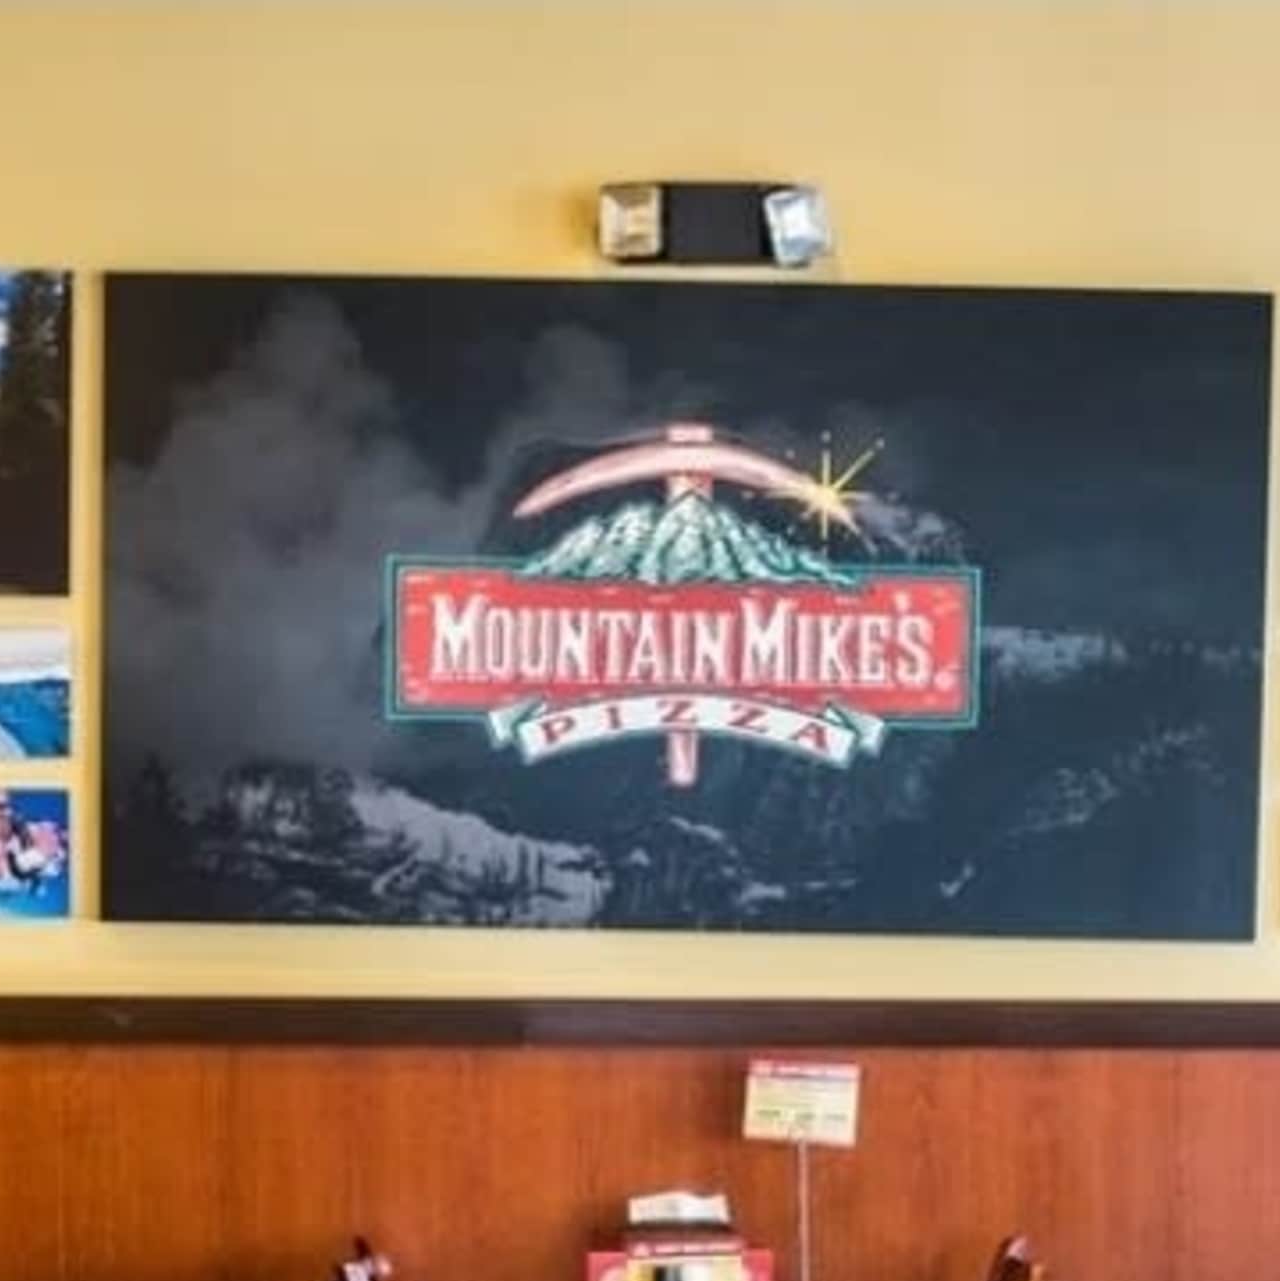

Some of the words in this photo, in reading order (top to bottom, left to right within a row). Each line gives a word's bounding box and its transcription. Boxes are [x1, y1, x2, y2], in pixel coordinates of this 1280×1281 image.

[430, 593, 737, 684] MOUNTAIN
[739, 591, 935, 689] MIKE'S
[540, 699, 833, 752] PIZZA
